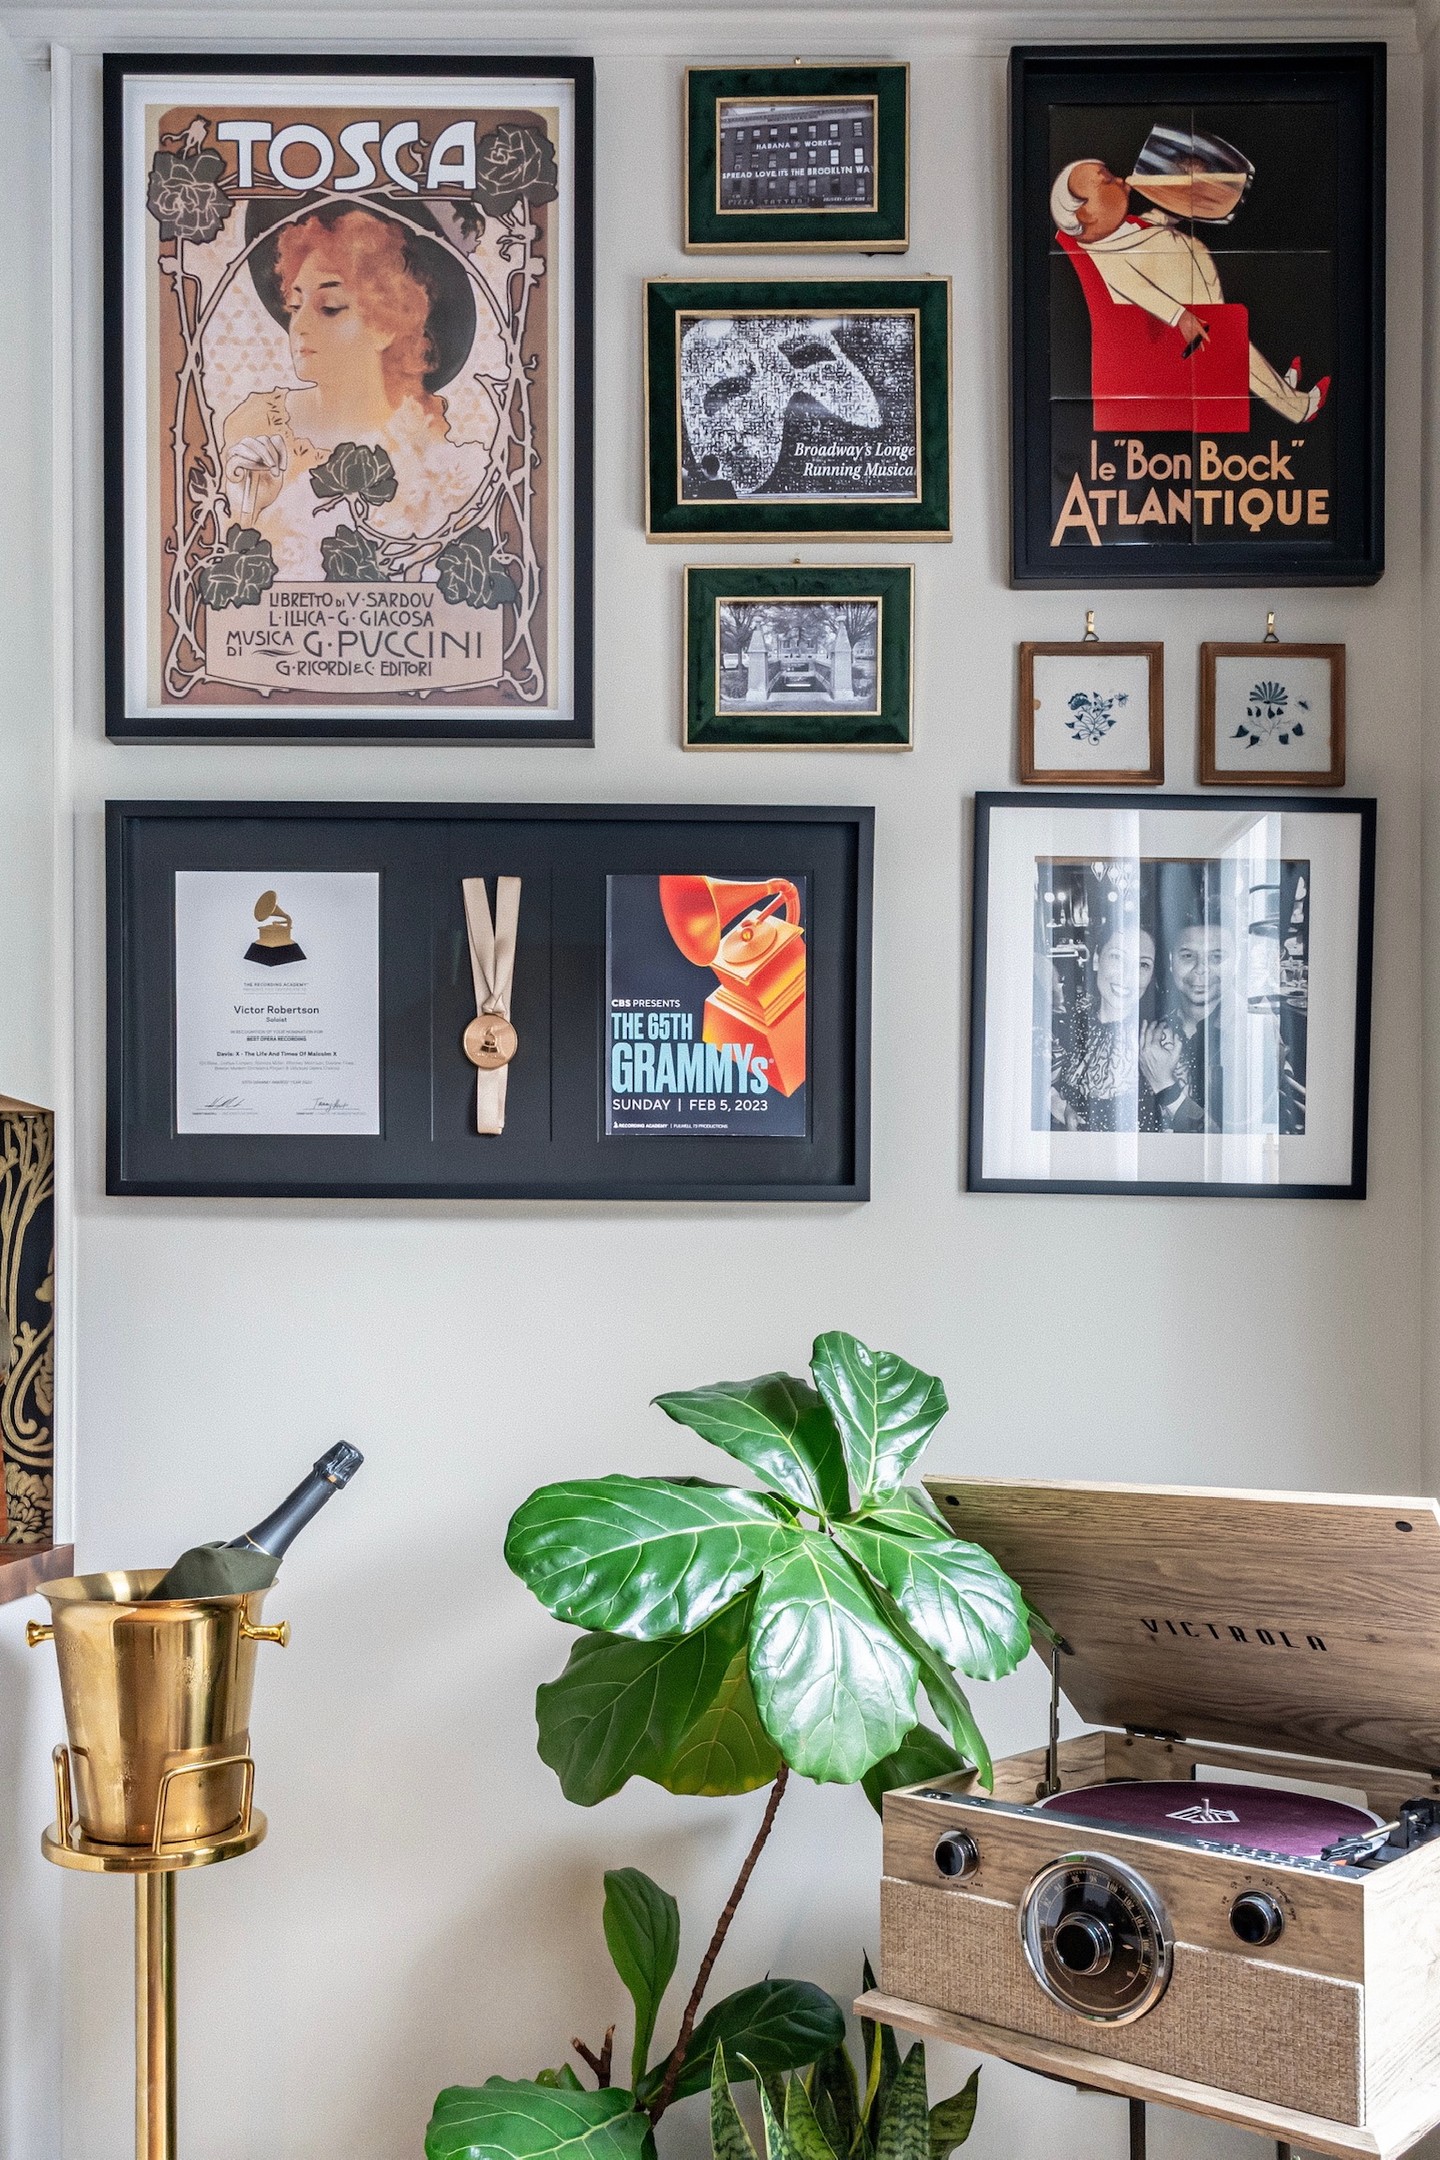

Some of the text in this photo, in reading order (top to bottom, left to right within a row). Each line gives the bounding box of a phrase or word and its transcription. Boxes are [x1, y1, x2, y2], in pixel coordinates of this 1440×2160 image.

[756, 142, 790, 150] HABANA
[217, 120, 478, 192] TOSCA
[790, 168, 804, 176] THE
[807, 166, 852, 175] BROOKLYN
[855, 165, 874, 174] WA
[794, 442, 872, 460] Broadway's
[1090, 440, 1117, 482] le
[803, 462, 916, 480] Running Musica
[1050, 472, 1330, 547] ATLANTIQUE
[270, 592, 332, 608] LIBRETTO
[226, 630, 294, 646] MUSICA
[338, 631, 482, 658] PUCCINI
[227, 646, 242, 656] DI
[381, 660, 432, 676] EDITORI
[234, 1005, 320, 1014] Victor Robertson
[611, 999, 681, 1008] CBS PRESENTS
[611, 1013, 693, 1040] THE 65TH
[612, 1099, 768, 1112] SUNDAY FEB 5, 2023
[1140, 1618, 1328, 1652] VICTROLA
